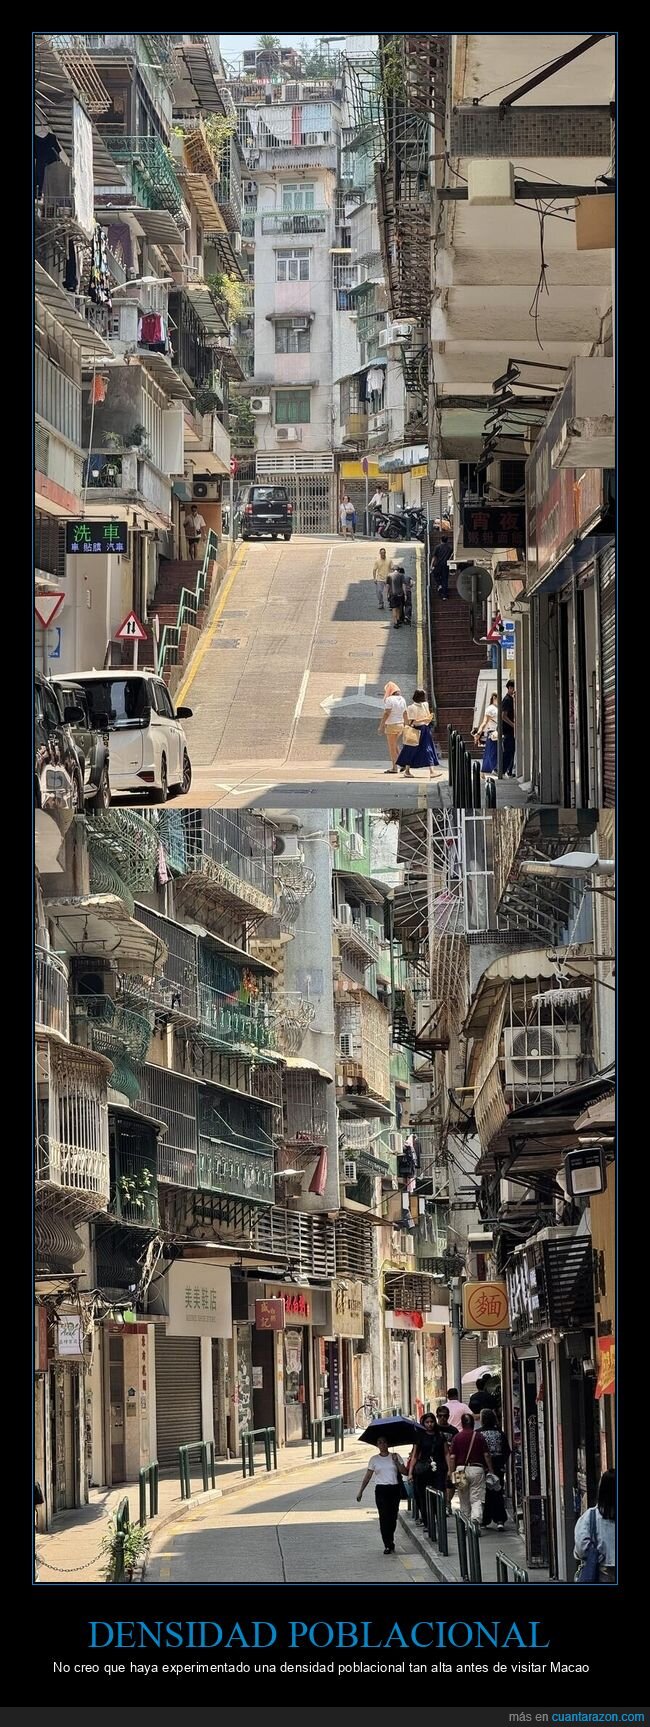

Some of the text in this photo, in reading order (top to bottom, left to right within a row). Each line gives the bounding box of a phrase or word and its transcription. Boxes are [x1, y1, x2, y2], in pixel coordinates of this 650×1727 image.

[74, 524, 120, 542] 洗車
[185, 1285, 217, 1311] 美美鞋店
[475, 1292, 502, 1318] 麵
